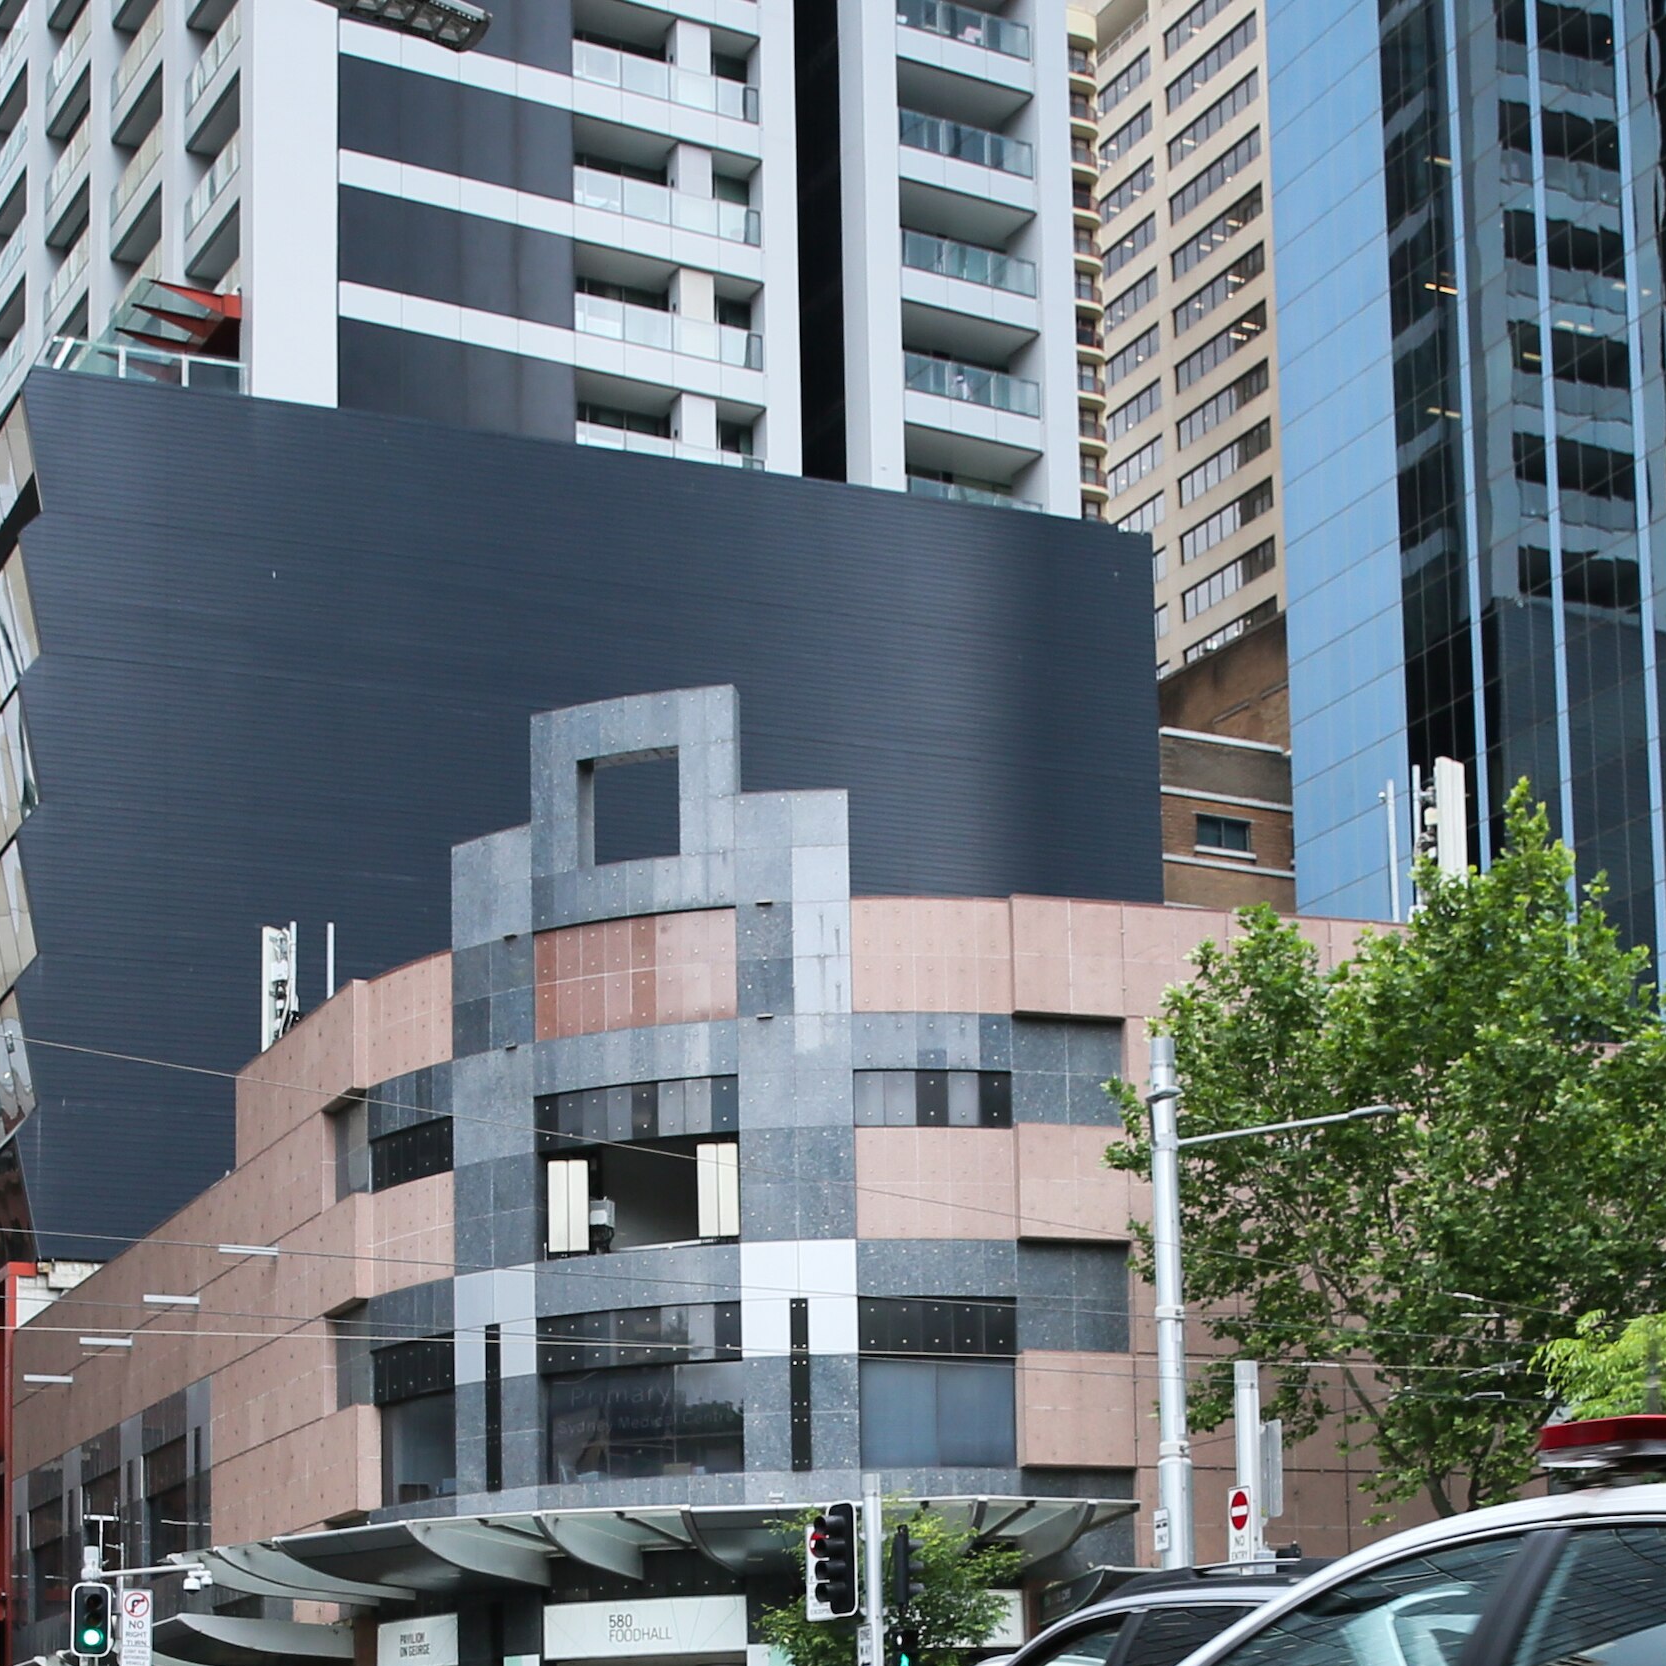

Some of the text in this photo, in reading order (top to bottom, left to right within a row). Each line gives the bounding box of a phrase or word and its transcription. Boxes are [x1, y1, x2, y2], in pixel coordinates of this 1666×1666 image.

[571, 1383, 670, 1407] Primary
[558, 1410, 735, 1434] Sydney Medical Centre
[128, 1621, 144, 1629] NO
[609, 1613, 632, 1628] 580
[609, 1627, 672, 1642] FOODHALL
[399, 1643, 430, 1658] ON GEORGE
